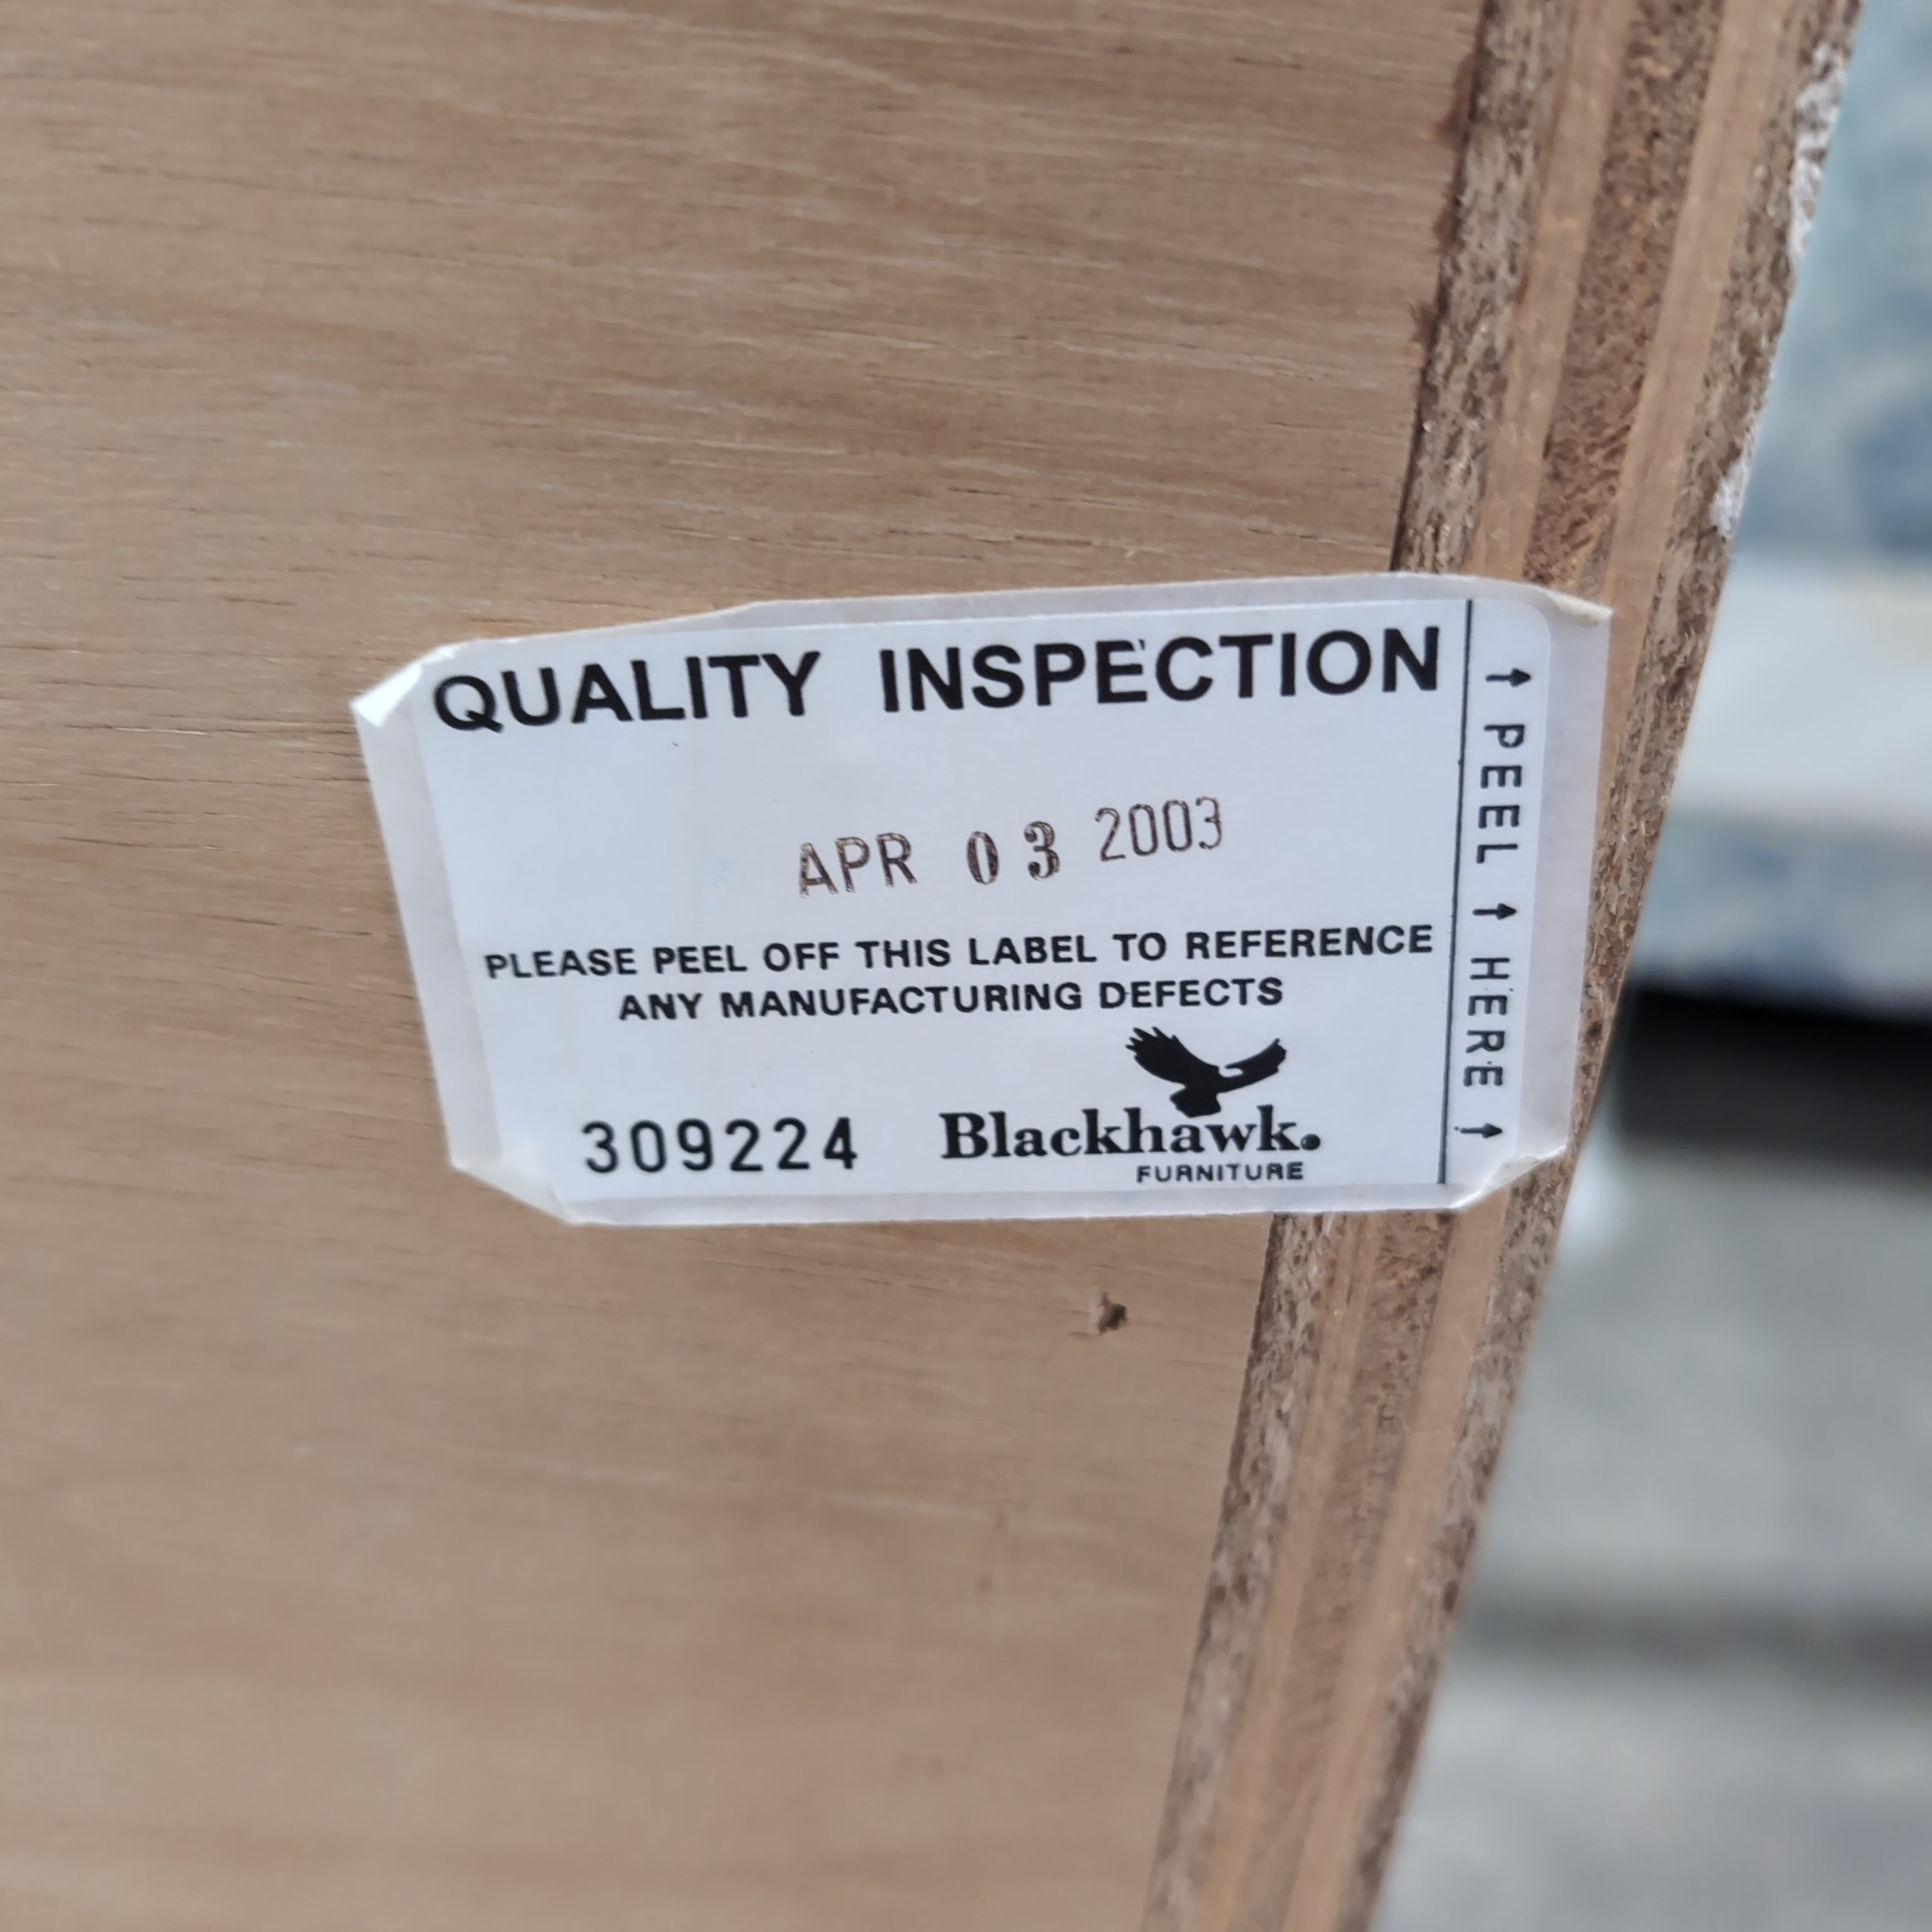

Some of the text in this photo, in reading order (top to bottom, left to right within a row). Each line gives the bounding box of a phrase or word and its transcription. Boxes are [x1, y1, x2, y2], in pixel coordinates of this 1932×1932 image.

[432, 626, 1440, 733] QUALITY INSPECTION
[799, 831, 917, 895] APR
[1095, 796, 1223, 862] 2003
[1463, 724, 1525, 1087] PEEL HERE
[484, 924, 1433, 979] PLEASE PEEL OFF THIS LABEL TO REFERENCE
[618, 977, 1283, 1021] ANY MANUFACTURING DEFECTS
[582, 1116, 858, 1174] 309224
[1137, 1161, 1304, 1183] FURNITURE
